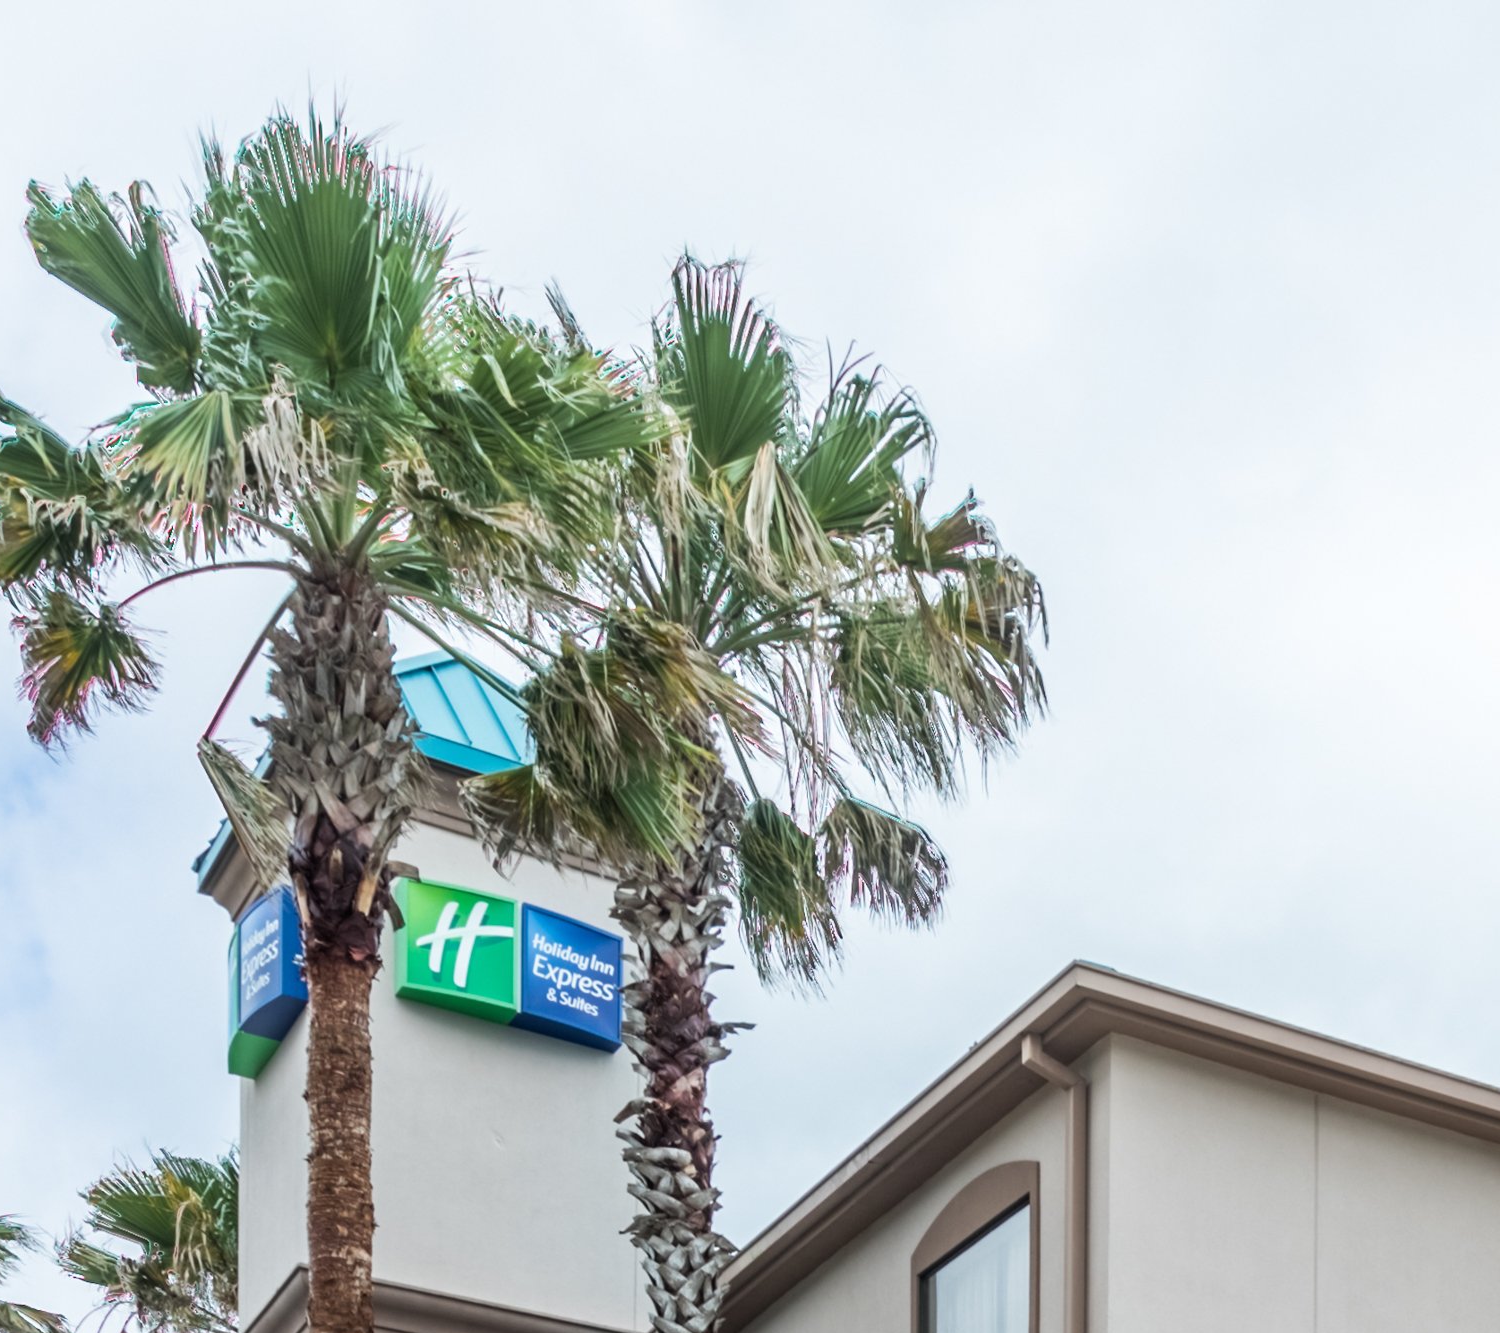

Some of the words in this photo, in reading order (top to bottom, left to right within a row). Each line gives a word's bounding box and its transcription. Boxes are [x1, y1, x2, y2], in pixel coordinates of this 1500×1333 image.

[532, 933, 589, 970] Holiday
[589, 953, 614, 976] Inn
[532, 954, 614, 1001] Express
[546, 987, 557, 1002] &
[559, 991, 599, 1016] Suites
